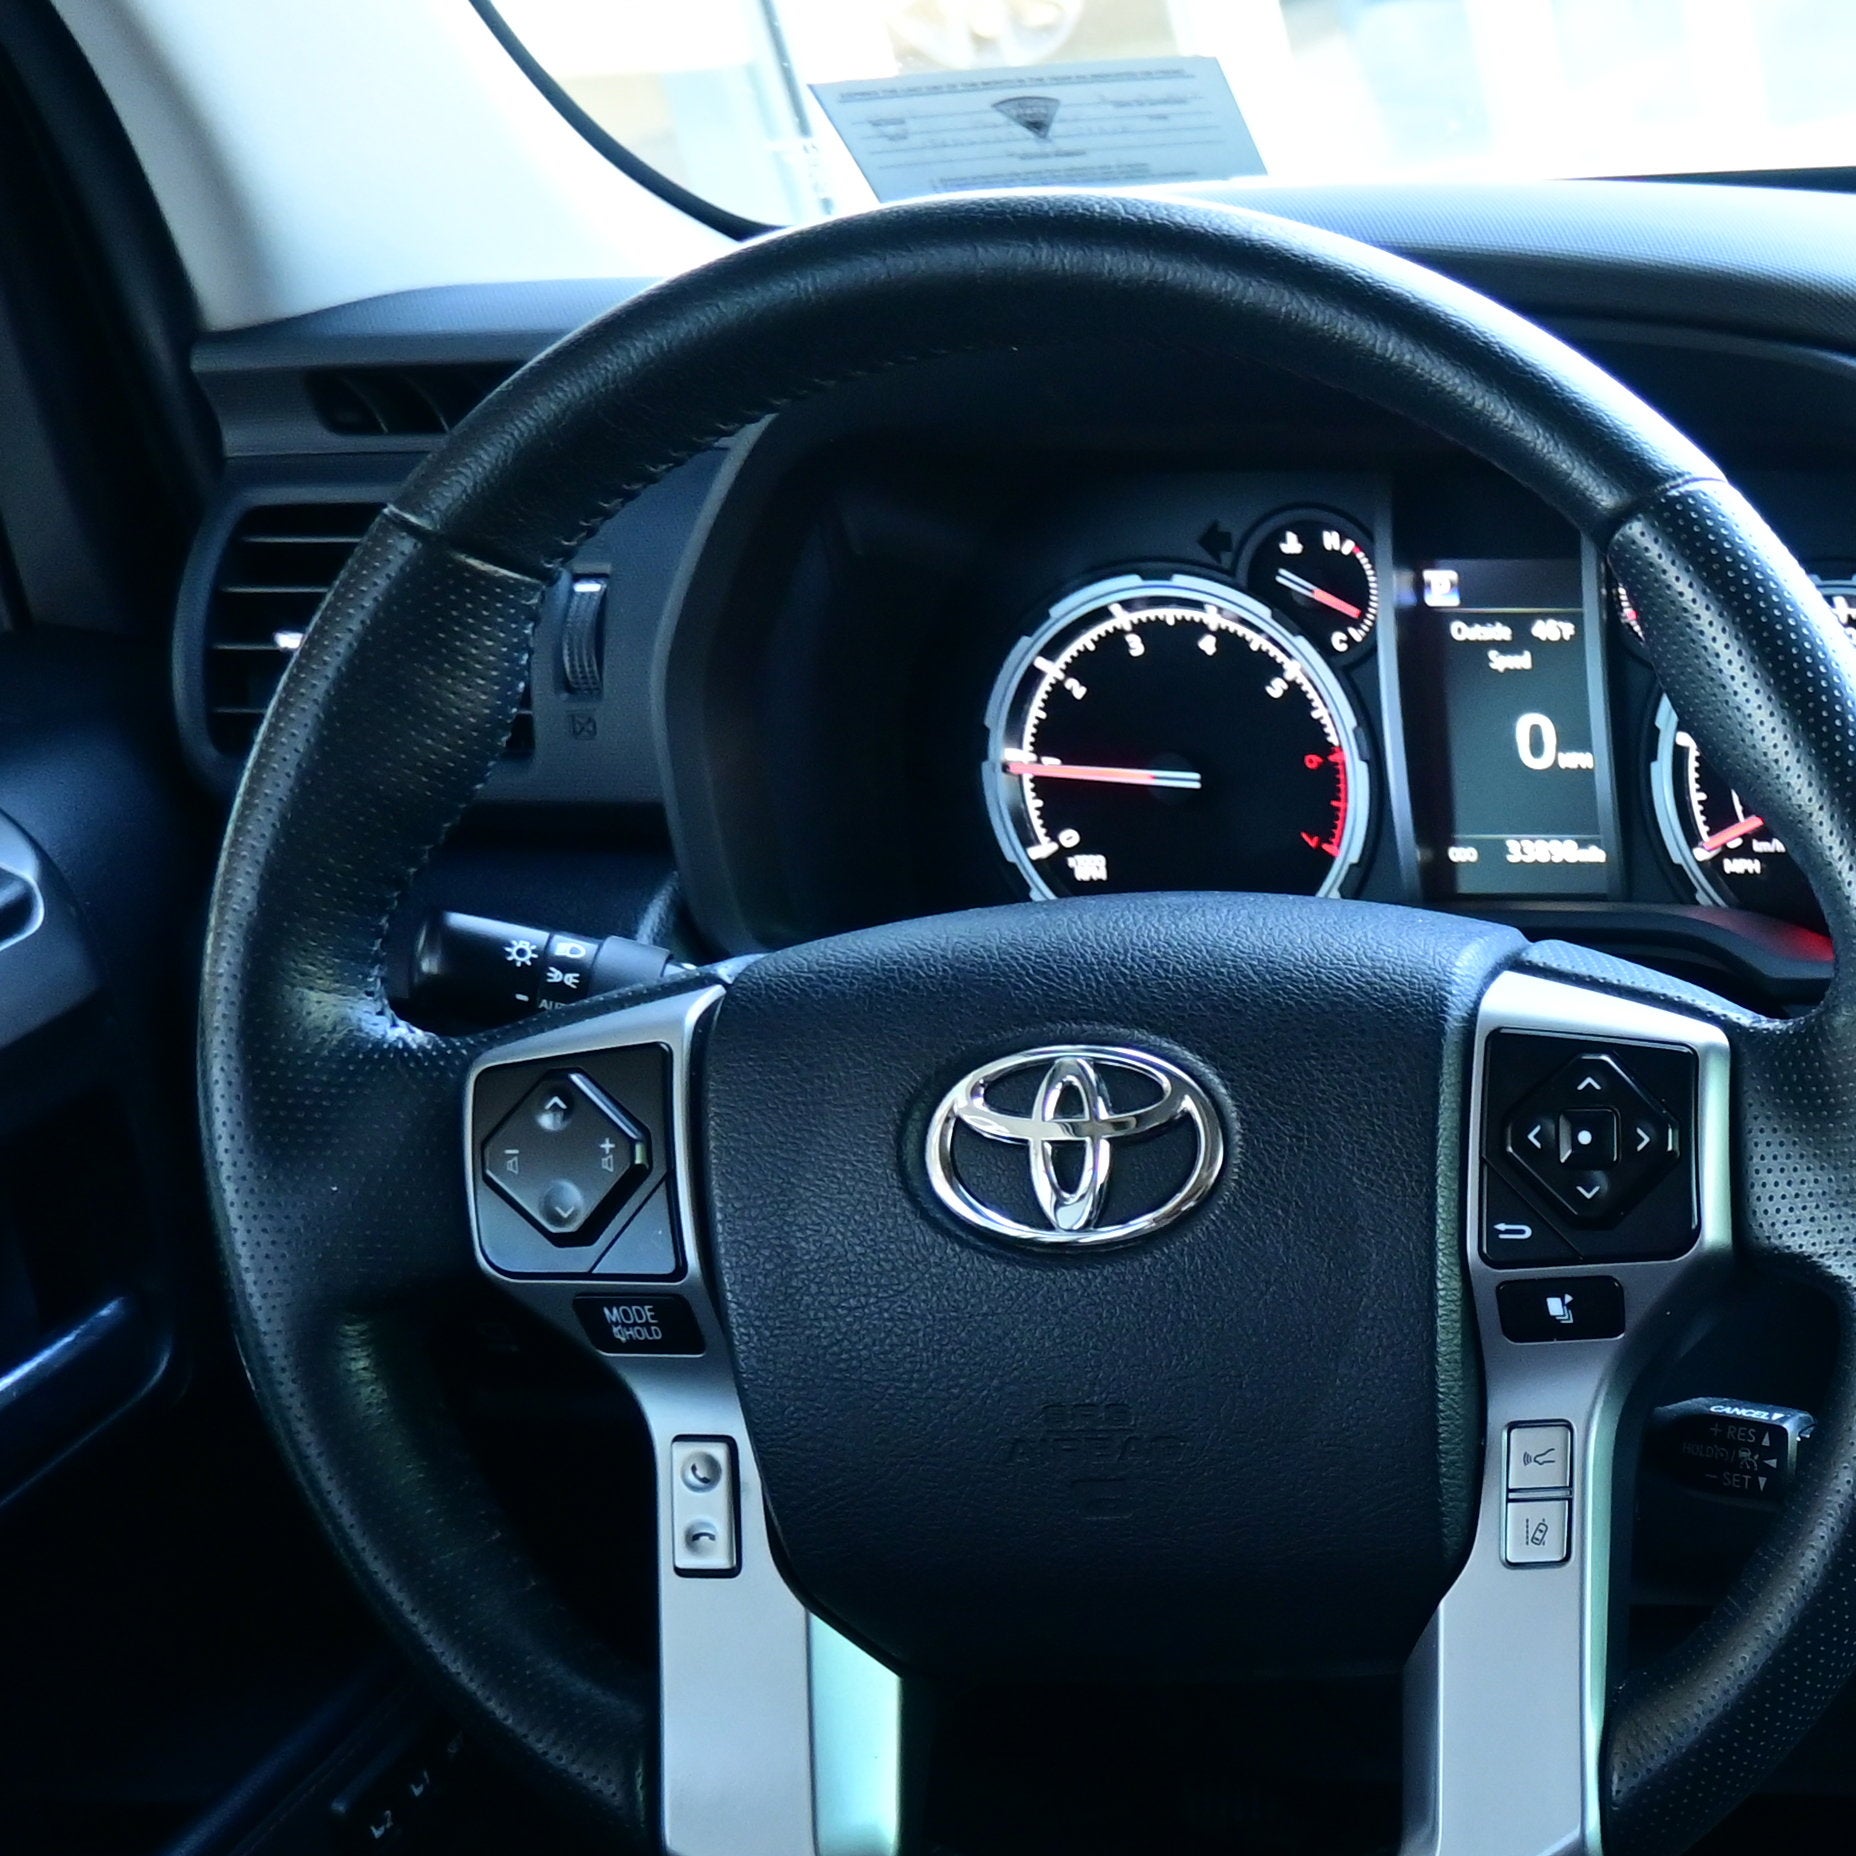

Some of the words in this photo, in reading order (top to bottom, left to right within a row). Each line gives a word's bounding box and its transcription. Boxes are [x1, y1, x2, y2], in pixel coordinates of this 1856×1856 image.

[1126, 632, 1146, 659] 3
[1198, 634, 1218, 657] 4
[1330, 630, 1349, 653] C
[1063, 678, 1089, 701] 2
[1264, 677, 1291, 700] 5
[1515, 712, 1557, 770] 0
[1303, 752, 1326, 770] 6
[1058, 828, 1080, 848] 0
[603, 1305, 659, 1324] MODE
[625, 1326, 662, 1341] HOLD
[1709, 1405, 1770, 1420] CANCEL
[1726, 1424, 1757, 1443] RES
[1722, 1471, 1753, 1490] SET
